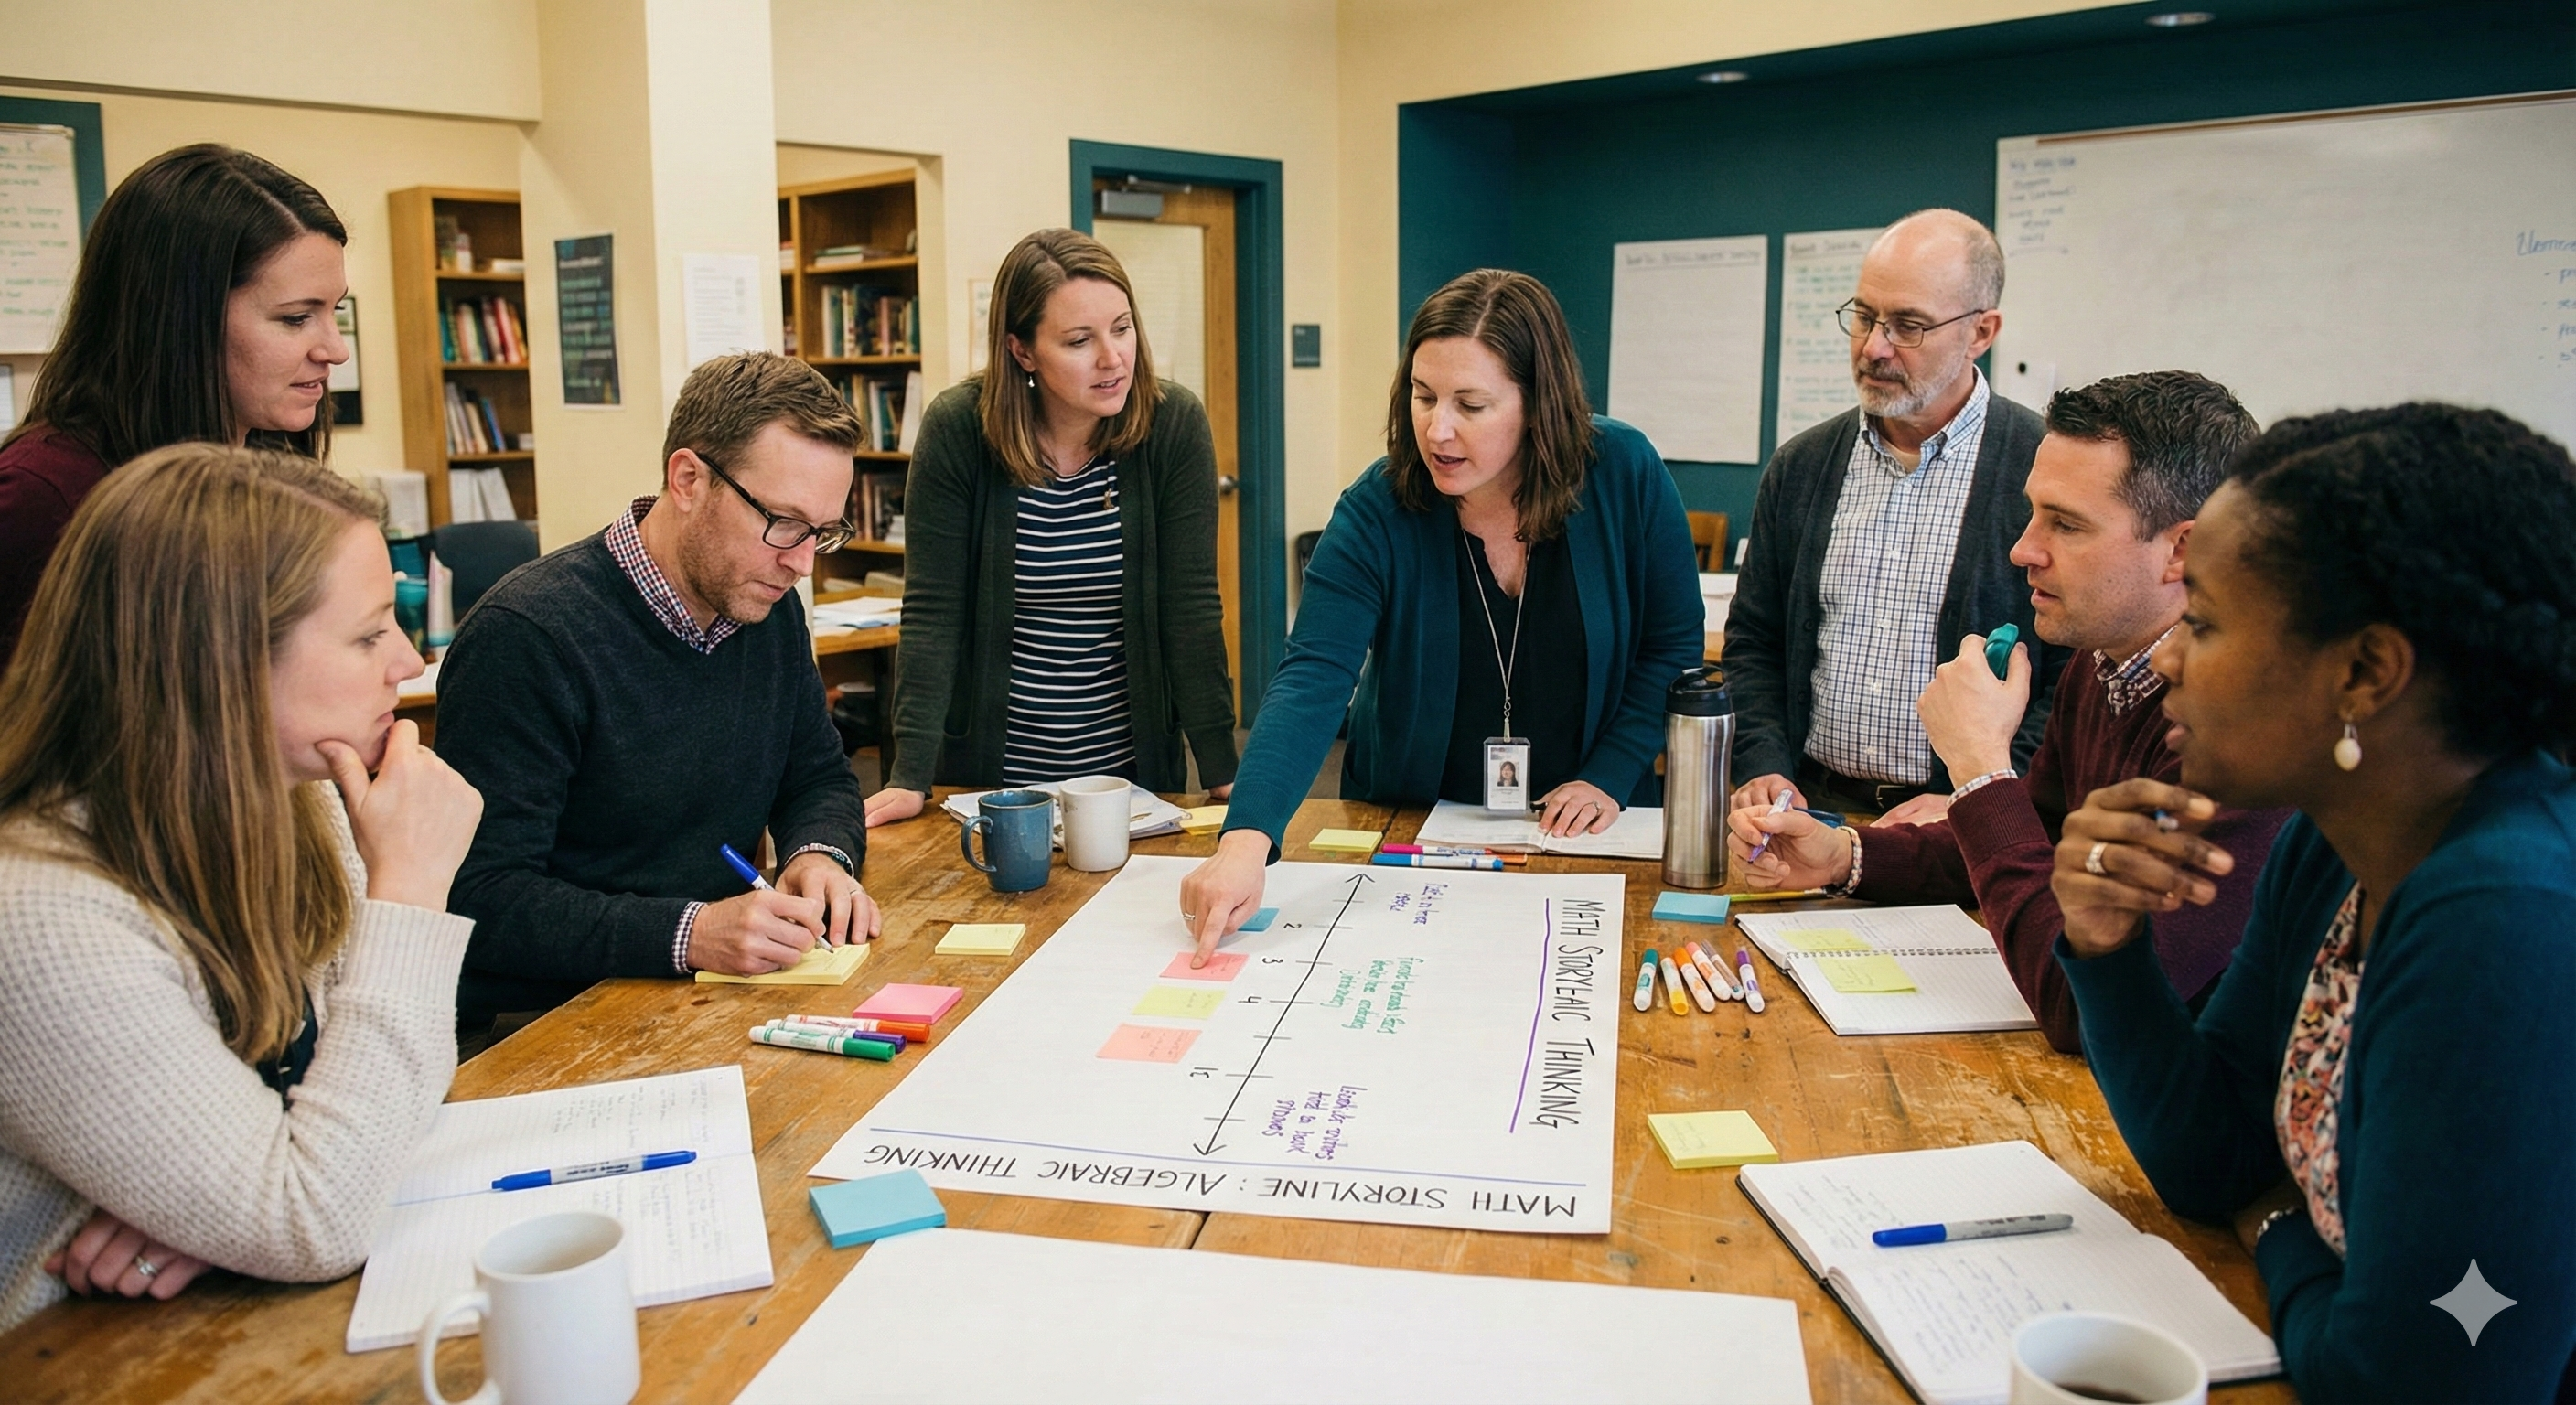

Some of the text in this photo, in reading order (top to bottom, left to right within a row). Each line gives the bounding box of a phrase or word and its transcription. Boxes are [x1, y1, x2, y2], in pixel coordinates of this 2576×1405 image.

[1283, 922, 1303, 930] 2
[1560, 899, 1606, 937] MATH
[1261, 957, 1284, 965] 3
[1238, 995, 1263, 1005] 4
[1529, 1037, 1595, 1129] THINKING
[864, 1143, 1017, 1178] THINKING
[1037, 1160, 1228, 1196] ALGEBRAIC
[1471, 1190, 1577, 1218] MATH
